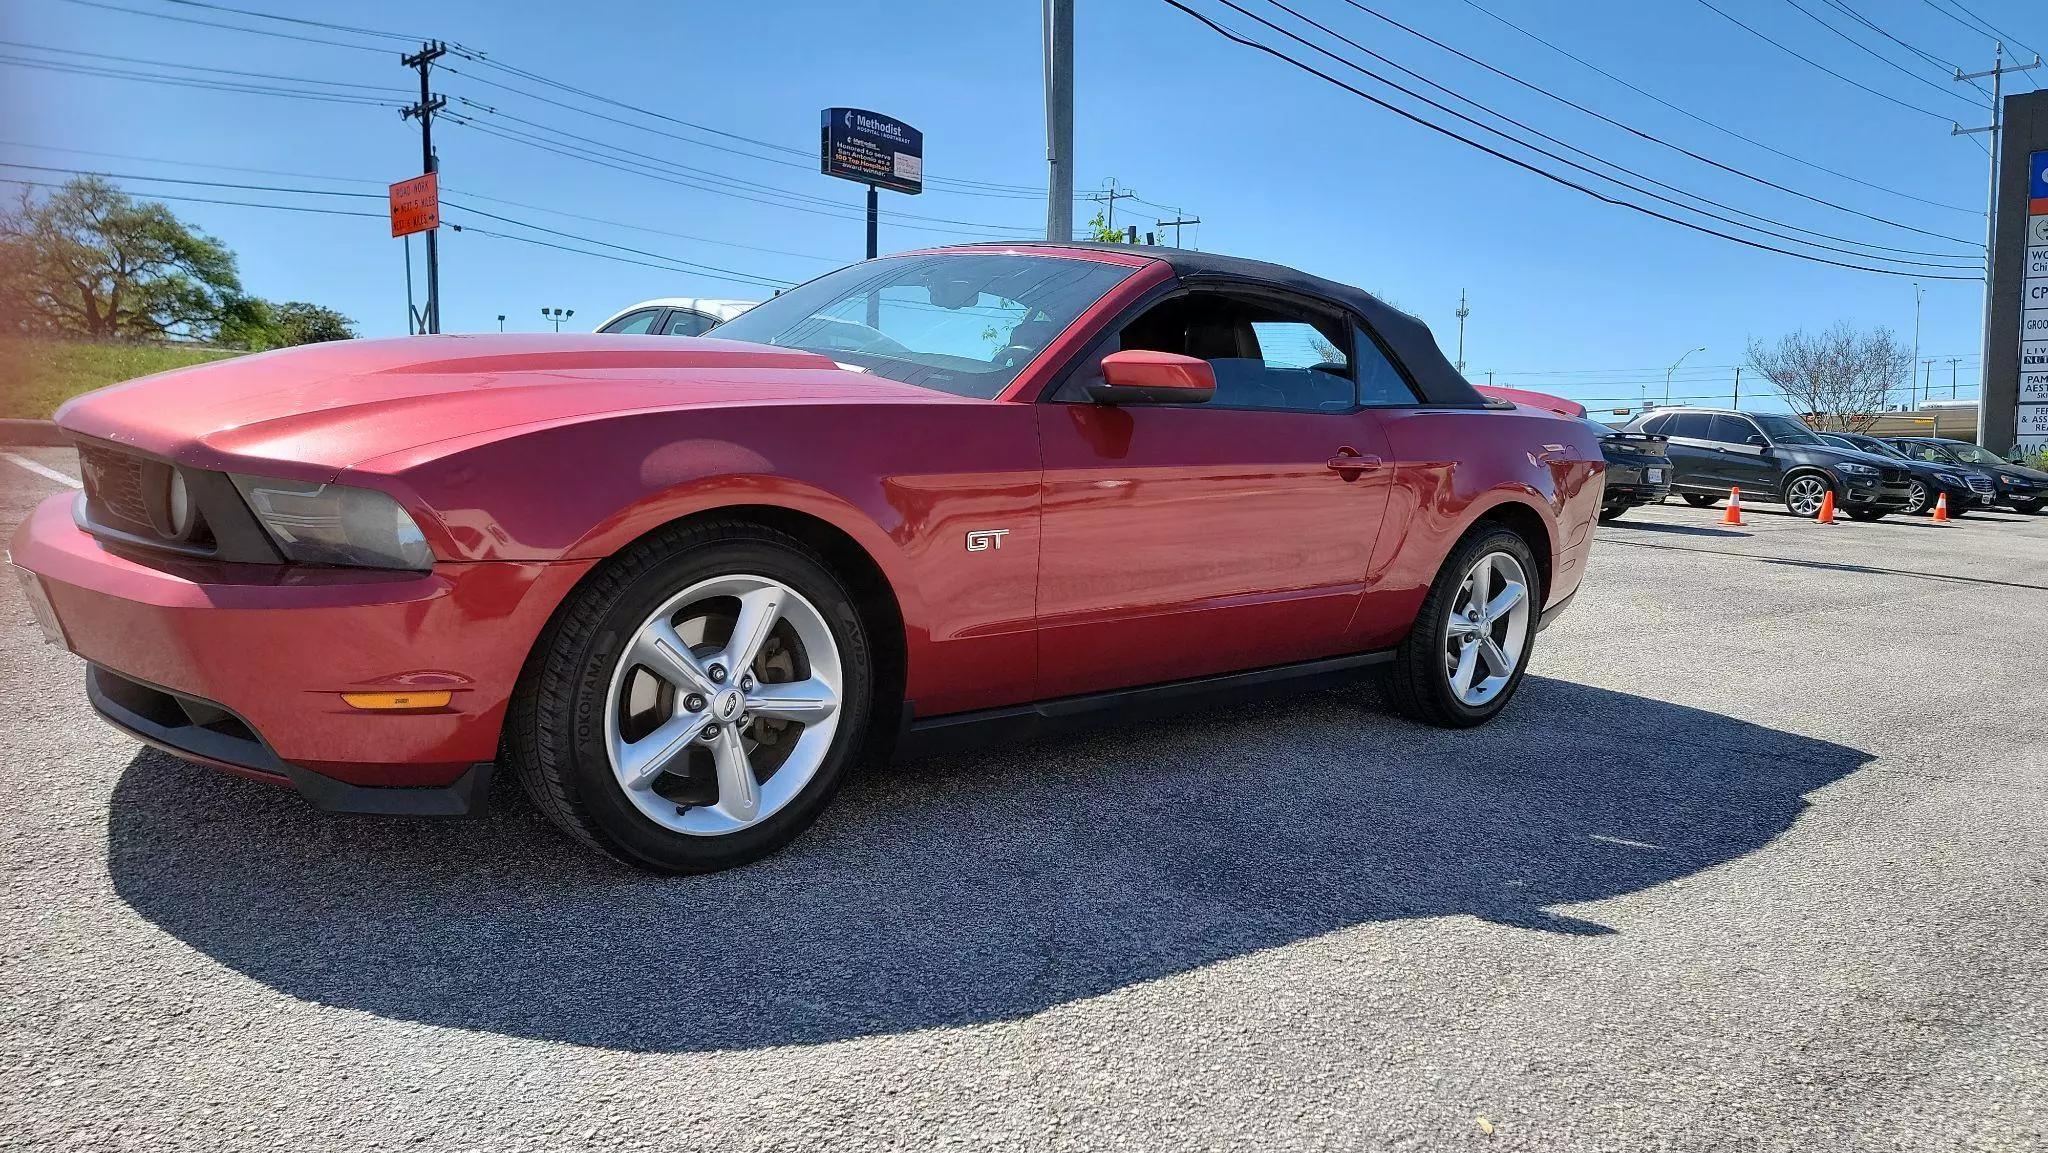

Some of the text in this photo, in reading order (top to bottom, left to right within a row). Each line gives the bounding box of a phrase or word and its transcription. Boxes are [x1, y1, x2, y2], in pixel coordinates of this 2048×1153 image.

[857, 115, 902, 136] Methodist
[857, 127, 879, 136] HOSPITAL
[837, 141, 865, 154] Honored
[838, 148, 850, 156] San
[852, 151, 876, 163] Antonio
[847, 156, 860, 165] Top
[414, 180, 429, 194] WORK
[421, 195, 435, 208] MILES
[967, 529, 1010, 552] GT
[577, 653, 606, 748] YOKOHAMA
